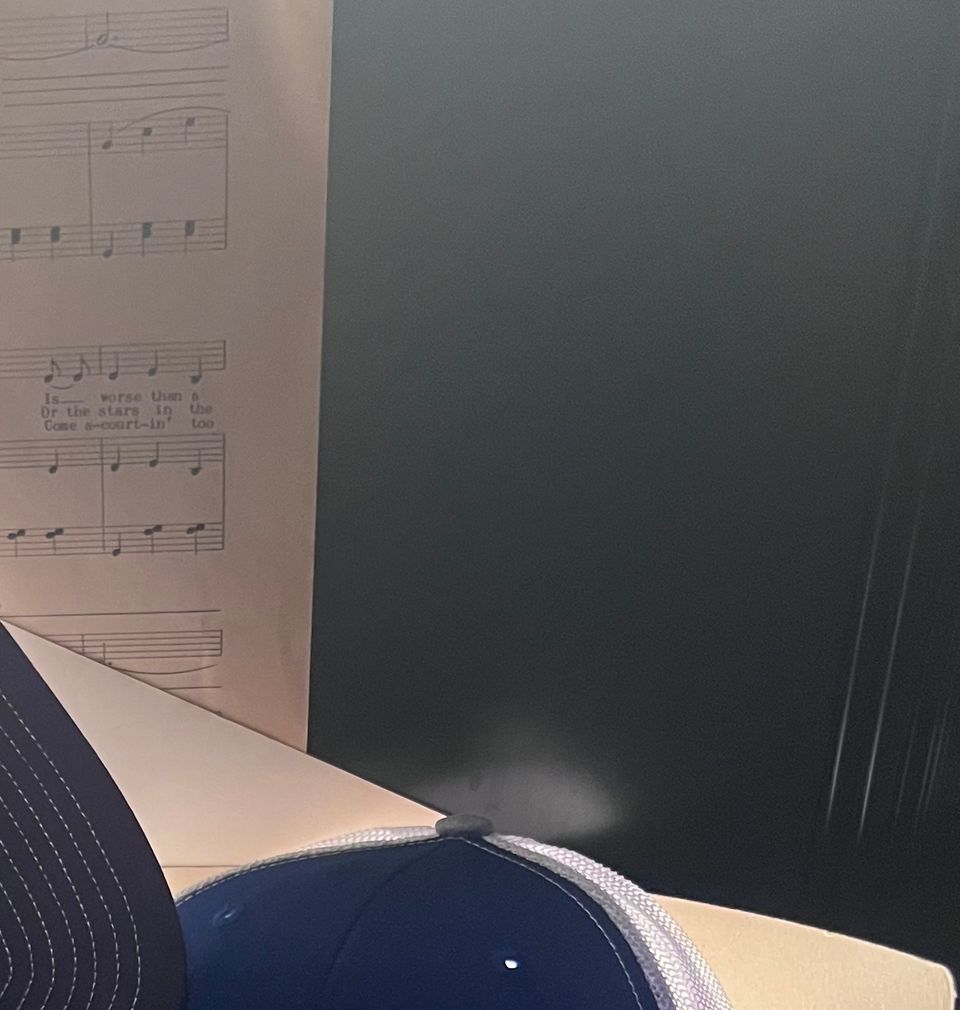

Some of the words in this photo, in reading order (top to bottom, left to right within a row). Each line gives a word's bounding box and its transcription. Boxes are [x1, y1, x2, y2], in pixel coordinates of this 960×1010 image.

[100, 391, 143, 404] worse
[150, 390, 183, 403] than
[40, 406, 58, 419] Or
[66, 405, 91, 418] the
[98, 404, 140, 417] stars
[155, 404, 173, 416] in
[189, 402, 213, 415] the
[43, 419, 78, 432] Come
[191, 418, 215, 430] too
